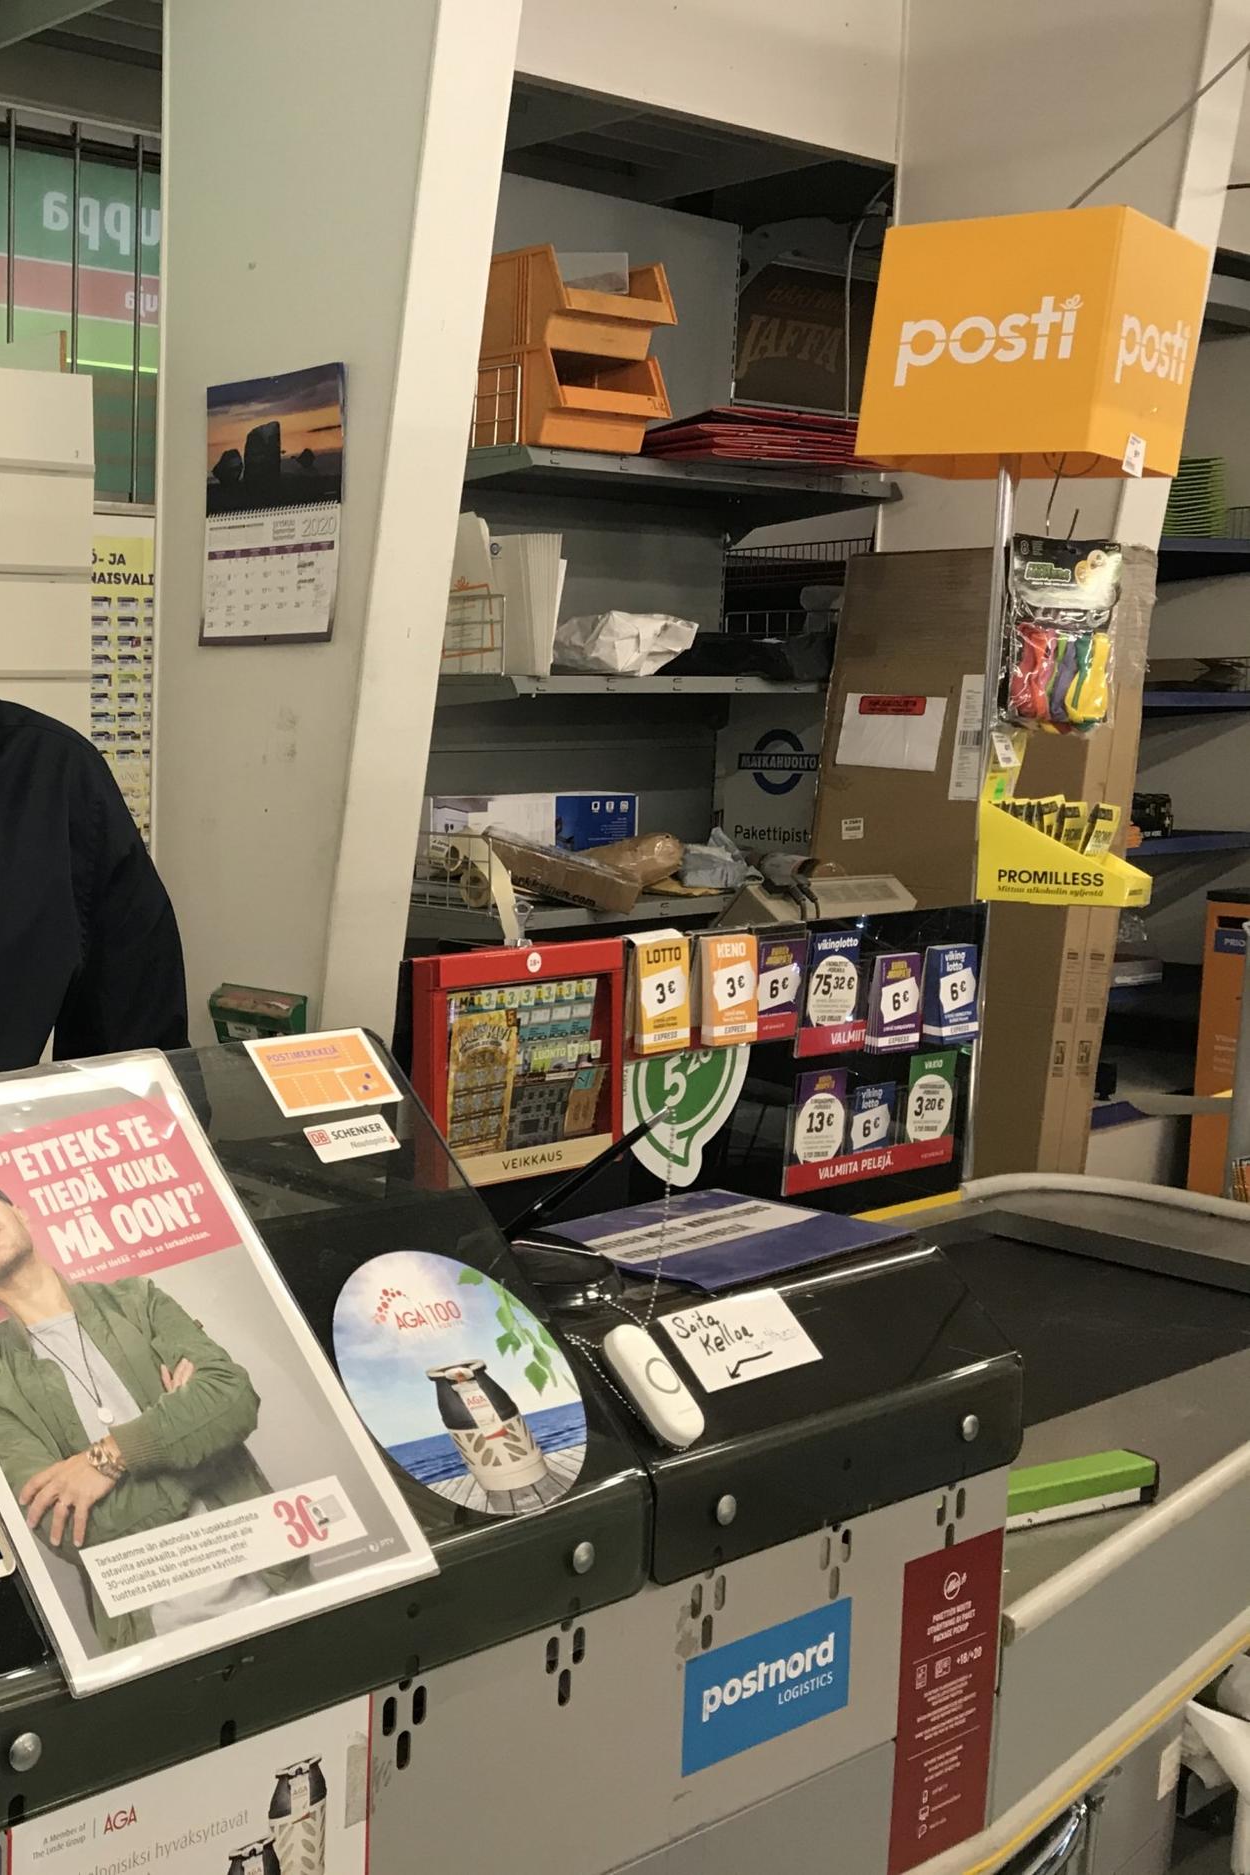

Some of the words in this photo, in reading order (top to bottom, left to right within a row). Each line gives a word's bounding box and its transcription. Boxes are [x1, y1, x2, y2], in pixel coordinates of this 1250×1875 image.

[894, 294, 1083, 387] posti
[1114, 314, 1191, 385] posti
[302, 516, 337, 537] 2020
[108, 553, 126, 565] JA
[741, 755, 817, 768] MATKAHUOLTO
[734, 825, 808, 845] Pakettipist
[998, 869, 1104, 887] PROMILLESS
[717, 942, 746, 958] KENO
[817, 937, 859, 952] vikinglotto
[1224, 937, 1247, 948] PRIO
[646, 946, 682, 964] LOTTO
[944, 950, 966, 963] viking
[946, 960, 964, 972] lotto
[653, 1031, 678, 1042] EXPRESS
[724, 1024, 748, 1034] EXPRESS
[830, 1028, 866, 1046] VALMIIT
[888, 1035, 910, 1045] EXPRESS
[861, 1087, 883, 1101] viking
[116, 1114, 160, 1152] TE
[307, 1130, 331, 1147] DB
[331, 1122, 384, 1141] SCHENKER
[502, 1150, 563, 1171] VEIKKAUS
[818, 1161, 859, 1180] VALMIITA
[860, 1150, 895, 1172] PELEJÄ.
[28, 1167, 108, 1217] TIEDÄ
[107, 1152, 179, 1194] KUKA
[47, 1206, 115, 1265] MÄ
[395, 1311, 427, 1330] AGA
[429, 1300, 462, 1322] 100
[671, 1310, 720, 1339] Soita
[699, 1323, 754, 1357] Kelloa
[466, 1394, 487, 1407] AGA
[95, 1547, 146, 1568] Tarkastamme
[177, 1543, 199, 1557] jotka
[158, 1562, 177, 1574] Näin
[702, 1631, 836, 1723] postnord
[778, 1671, 834, 1705] LOGISTICS
[103, 1804, 138, 1835] AGA
[49, 1828, 78, 1845] Member
[65, 1834, 87, 1851] Group
[155, 1809, 250, 1859] hyväksyttävät
